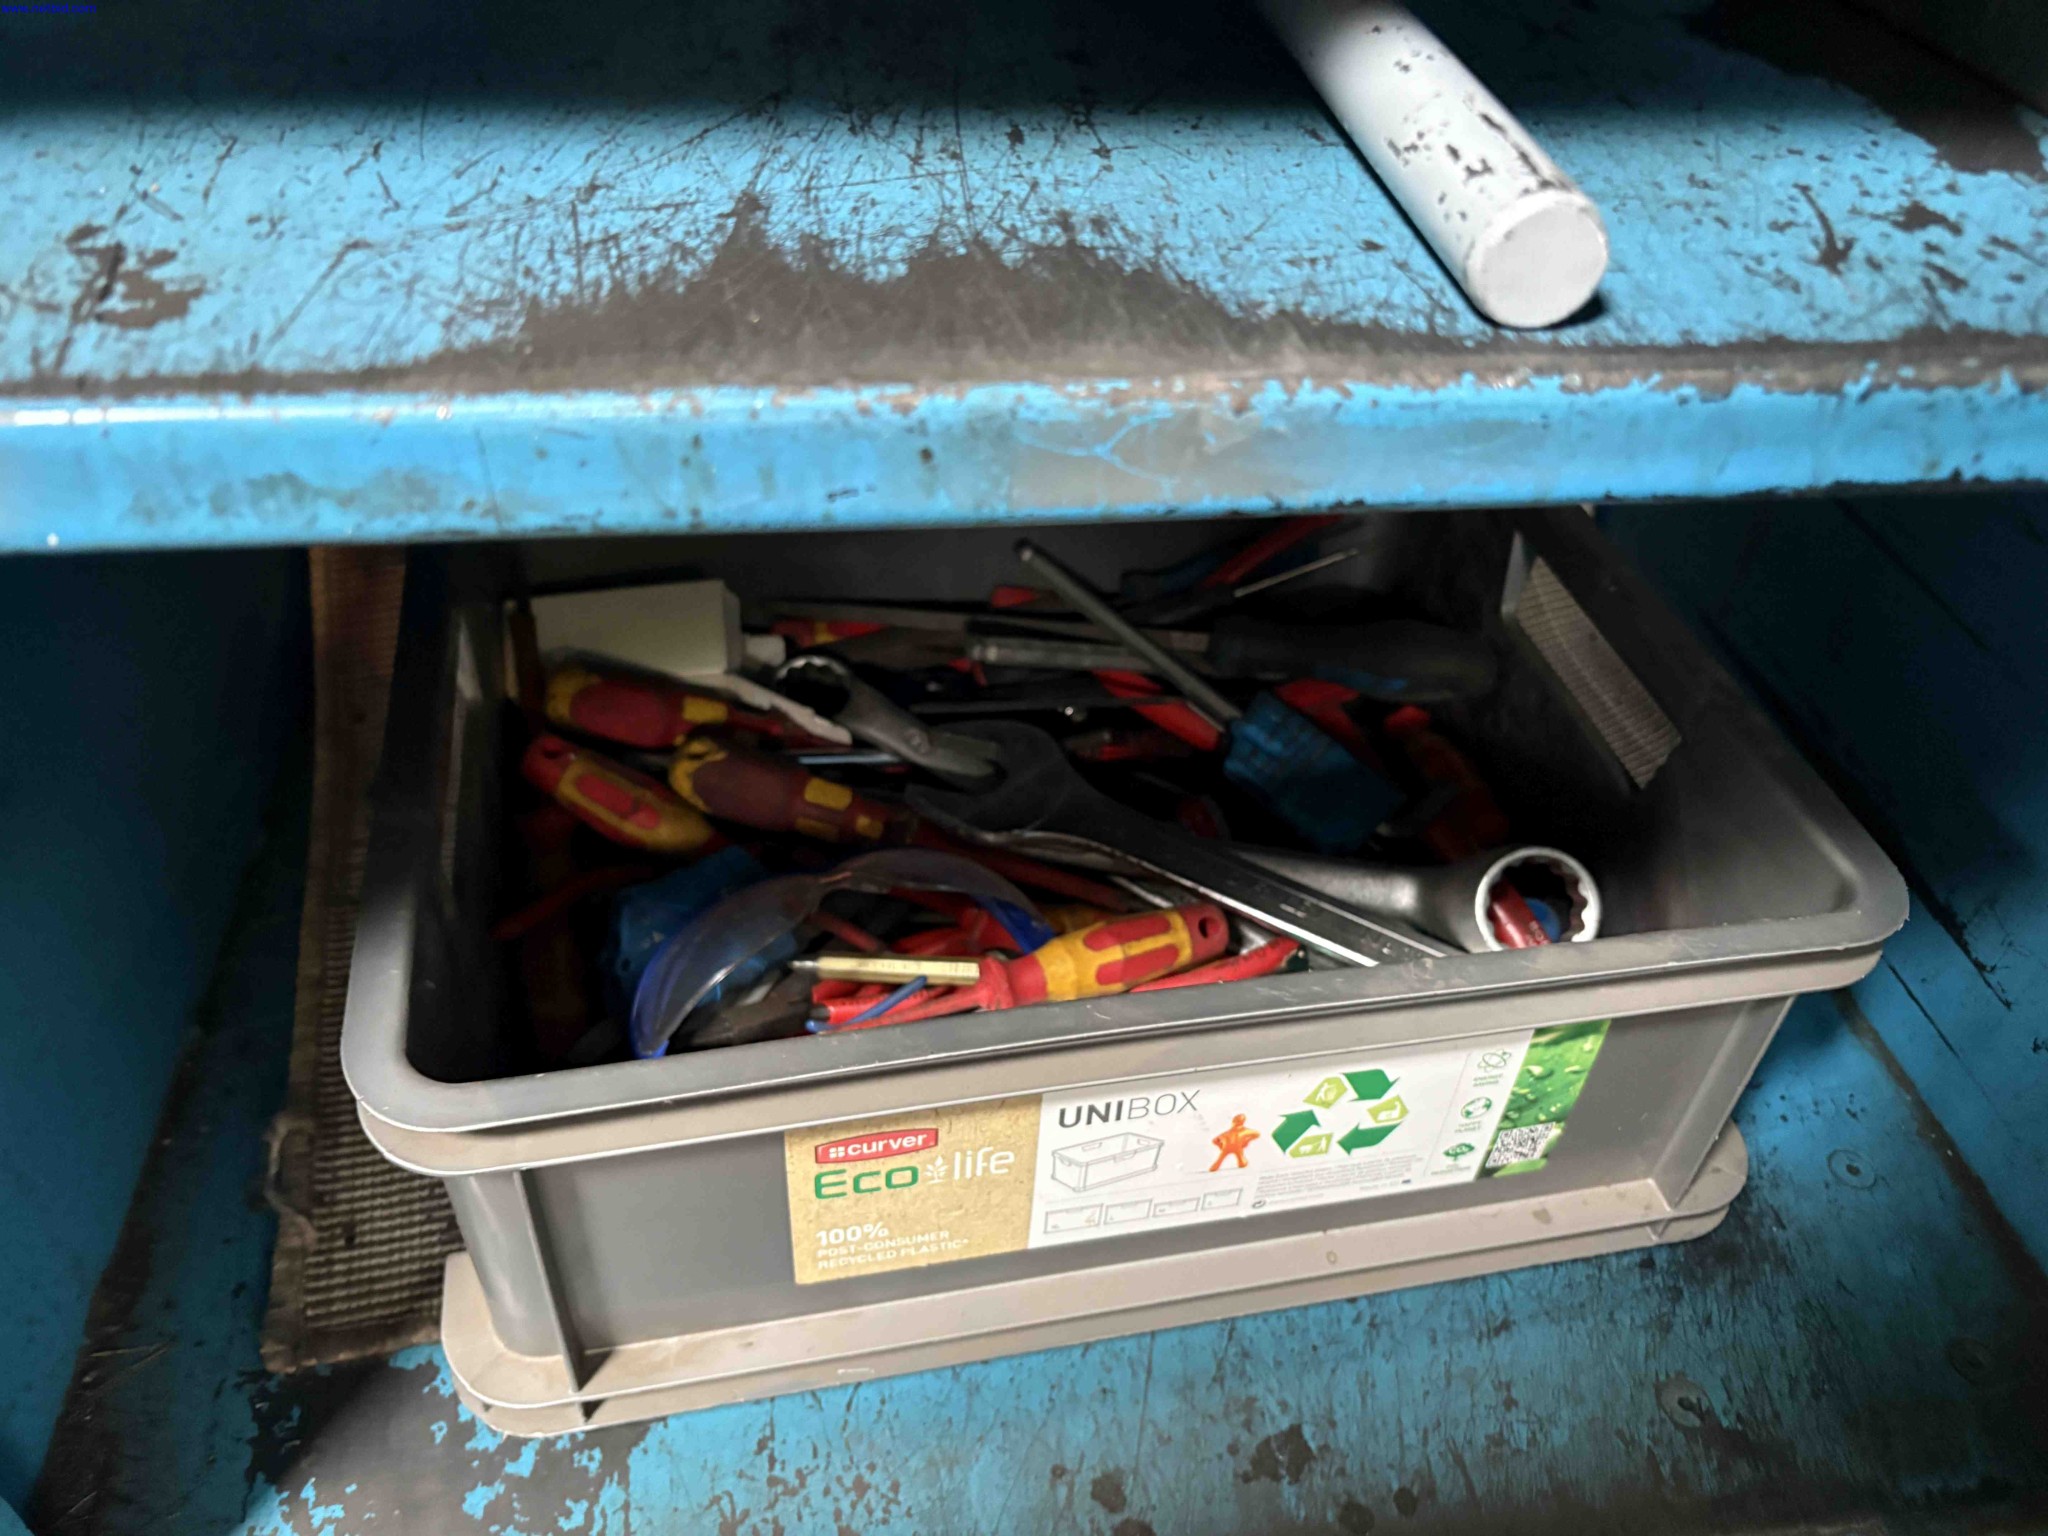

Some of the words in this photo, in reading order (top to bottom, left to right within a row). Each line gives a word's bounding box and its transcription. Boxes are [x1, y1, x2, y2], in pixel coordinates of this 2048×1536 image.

[1058, 1089, 1201, 1129] UNIBOX
[846, 1132, 928, 1157] curver
[953, 1146, 1016, 1182] life
[816, 1221, 890, 1247] 100%
[816, 1230, 951, 1258] POST-CONSUMER
[817, 1249, 900, 1270] RECYCLED
